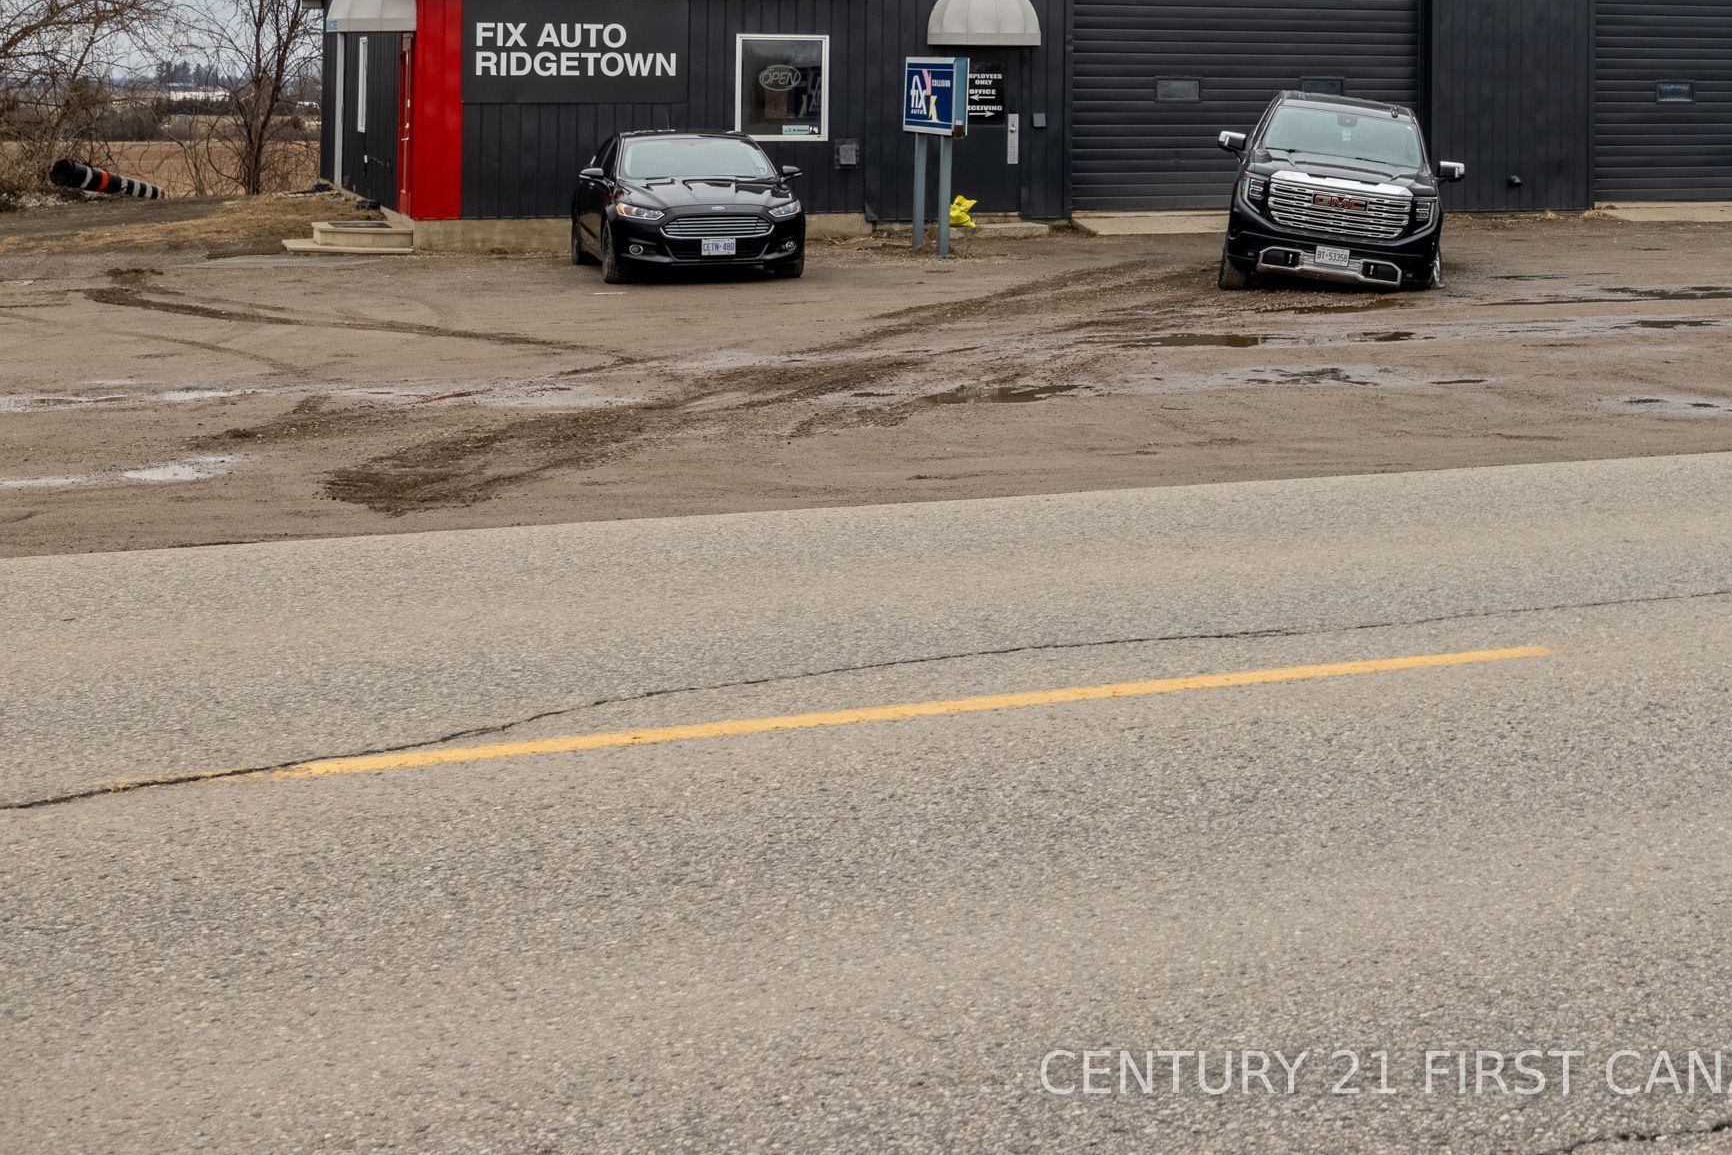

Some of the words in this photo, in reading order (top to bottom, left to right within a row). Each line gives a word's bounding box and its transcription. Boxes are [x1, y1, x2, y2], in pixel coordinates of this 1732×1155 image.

[475, 22, 528, 47] FIX
[536, 23, 627, 48] AUTO
[475, 51, 677, 77] RIDGETOWN
[762, 71, 798, 85] OPEN
[1314, 194, 1367, 211] GMC
